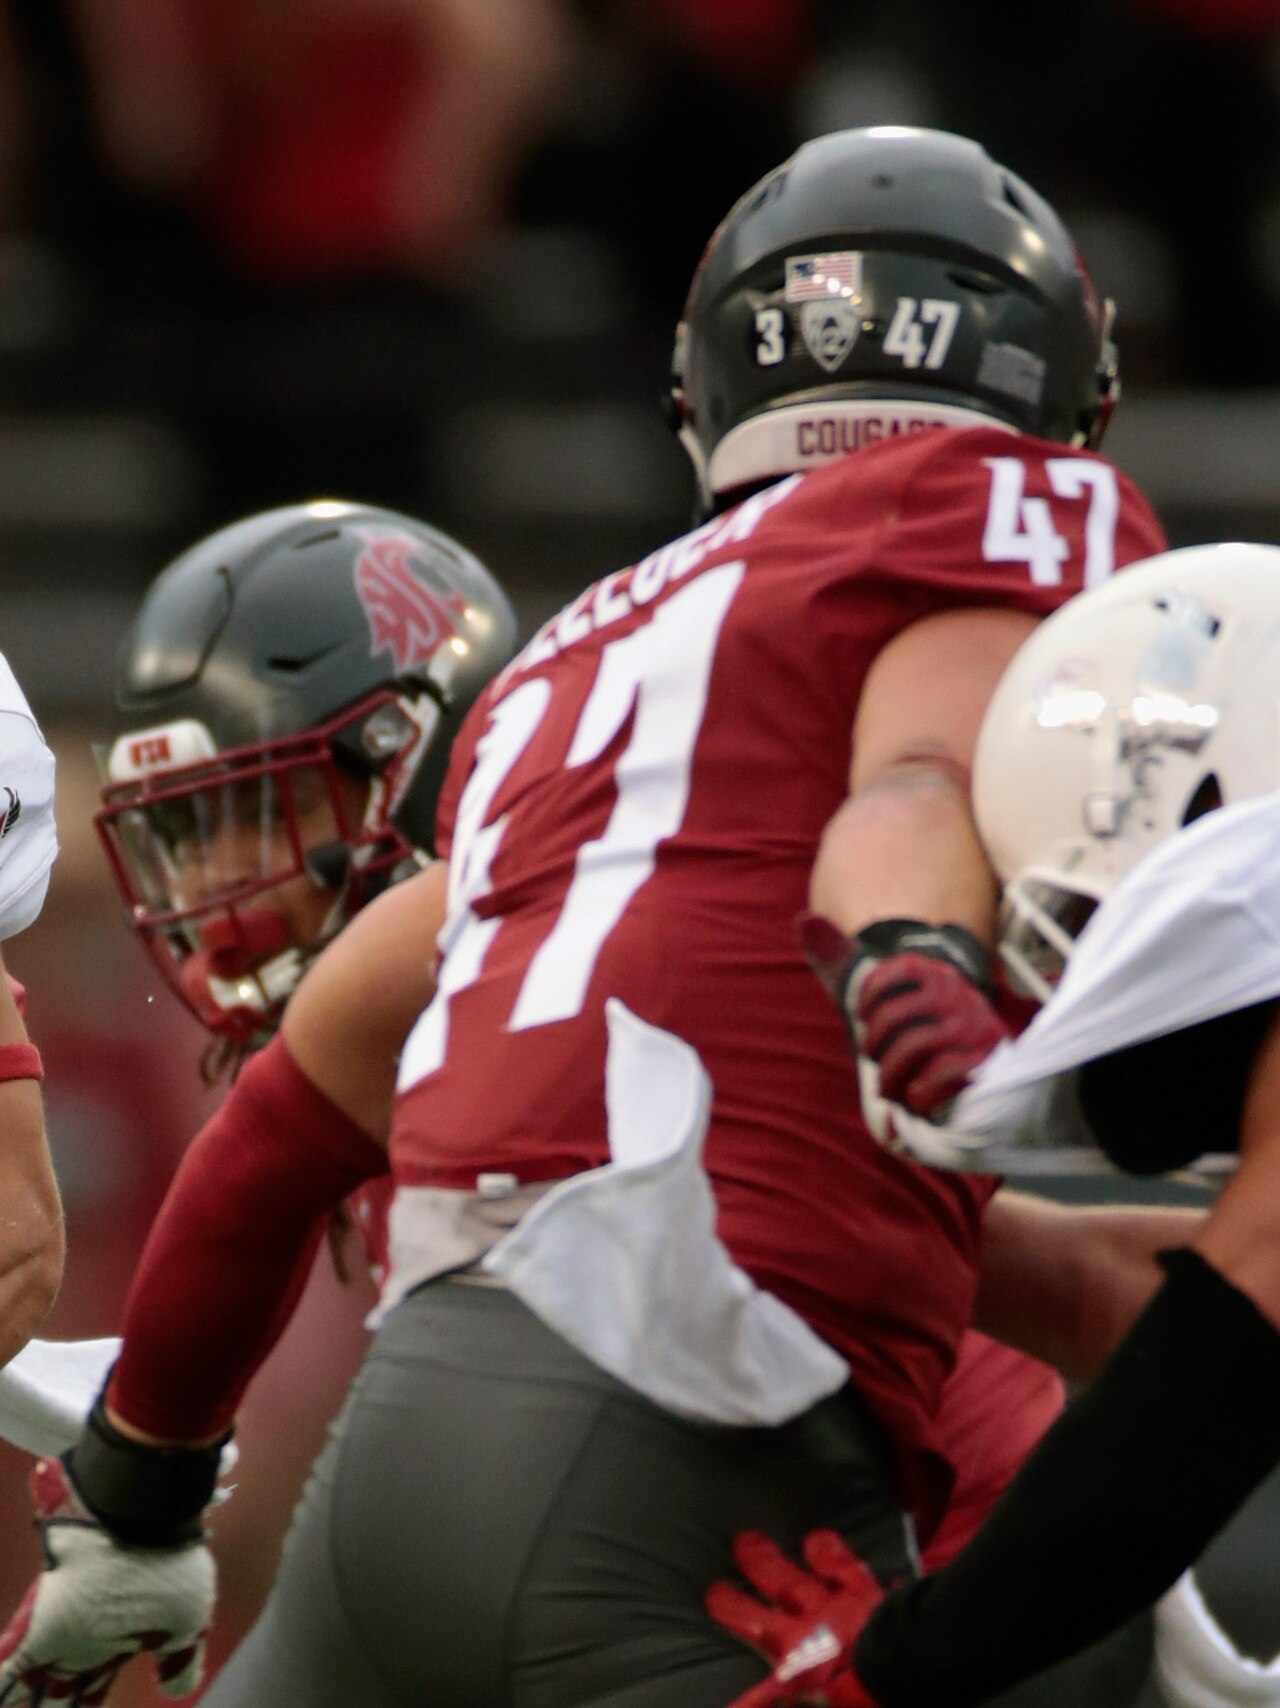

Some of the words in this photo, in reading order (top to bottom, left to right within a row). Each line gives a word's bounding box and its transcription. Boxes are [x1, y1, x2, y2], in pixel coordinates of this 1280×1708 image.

[755, 309, 785, 366] 3
[883, 297, 960, 369] 47
[982, 456, 1119, 591] 47
